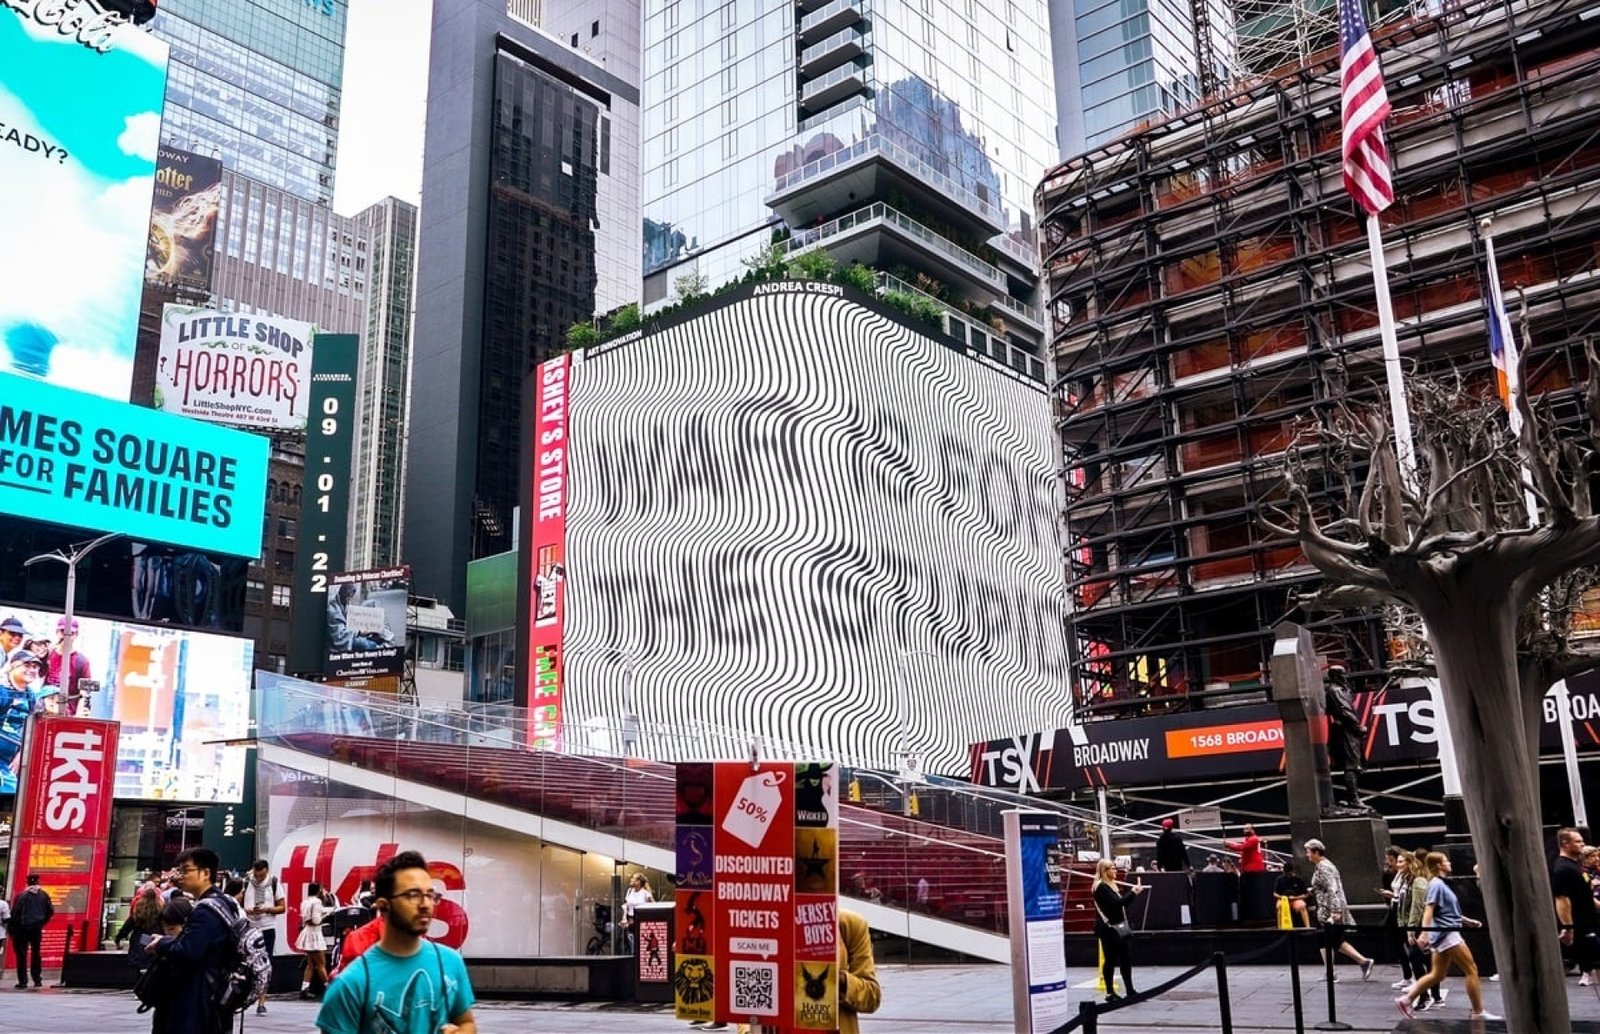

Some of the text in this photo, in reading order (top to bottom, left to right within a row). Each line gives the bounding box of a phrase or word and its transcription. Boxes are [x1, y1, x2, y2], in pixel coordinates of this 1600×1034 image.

[753, 281, 844, 297] ANDREA CRESPI
[178, 316, 304, 359] LITTLE SHOP
[173, 349, 299, 414] HORRORS
[193, 399, 273, 415] LittleShopNYC.com
[0, 404, 238, 491] MES SQUARE
[0, 450, 233, 529] FOR FAMILIES
[539, 447, 563, 522] STORE
[535, 644, 558, 700] FREE
[1542, 693, 1600, 723] BOA
[1190, 726, 1285, 749] 1568 BROAD
[981, 734, 1042, 795] TSX
[1073, 738, 1149, 768] BROADWAY
[45, 728, 104, 831] tkts
[737, 797, 769, 823] 50%
[715, 855, 793, 875] DISCOUNTED
[280, 837, 469, 953] tks
[718, 882, 790, 902] BROADWAY
[728, 909, 780, 929] TICKETS
[795, 901, 836, 925] JERSEY
[737, 942, 771, 951] SCAN ME
[804, 924, 834, 945] BOYS
